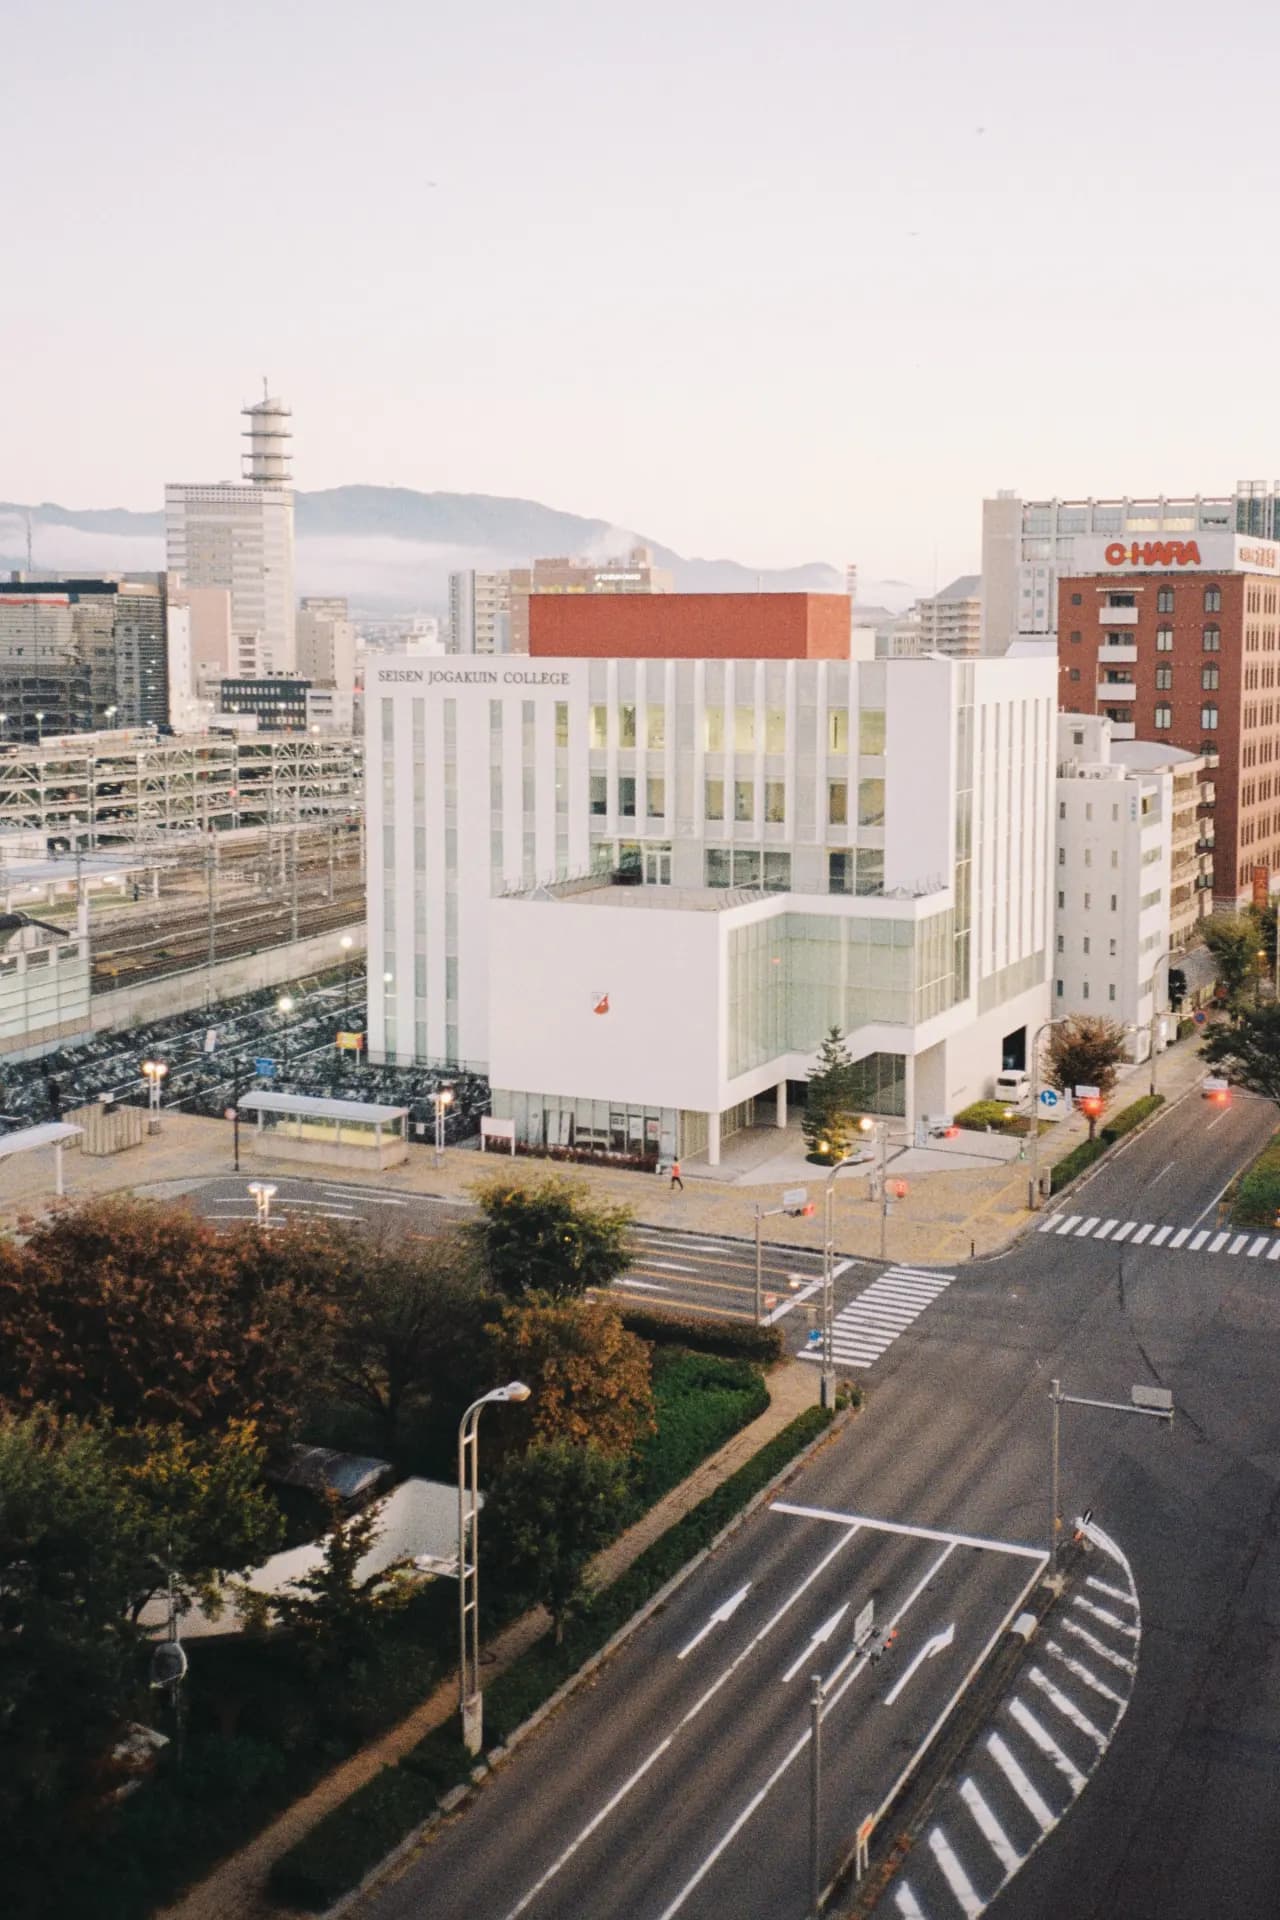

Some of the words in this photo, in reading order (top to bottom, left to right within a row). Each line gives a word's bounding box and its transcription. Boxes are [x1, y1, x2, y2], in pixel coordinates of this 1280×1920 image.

[378, 670, 423, 683] SEISEN
[428, 671, 498, 686] JOGAKUIN
[503, 671, 570, 685] COLLEGE
